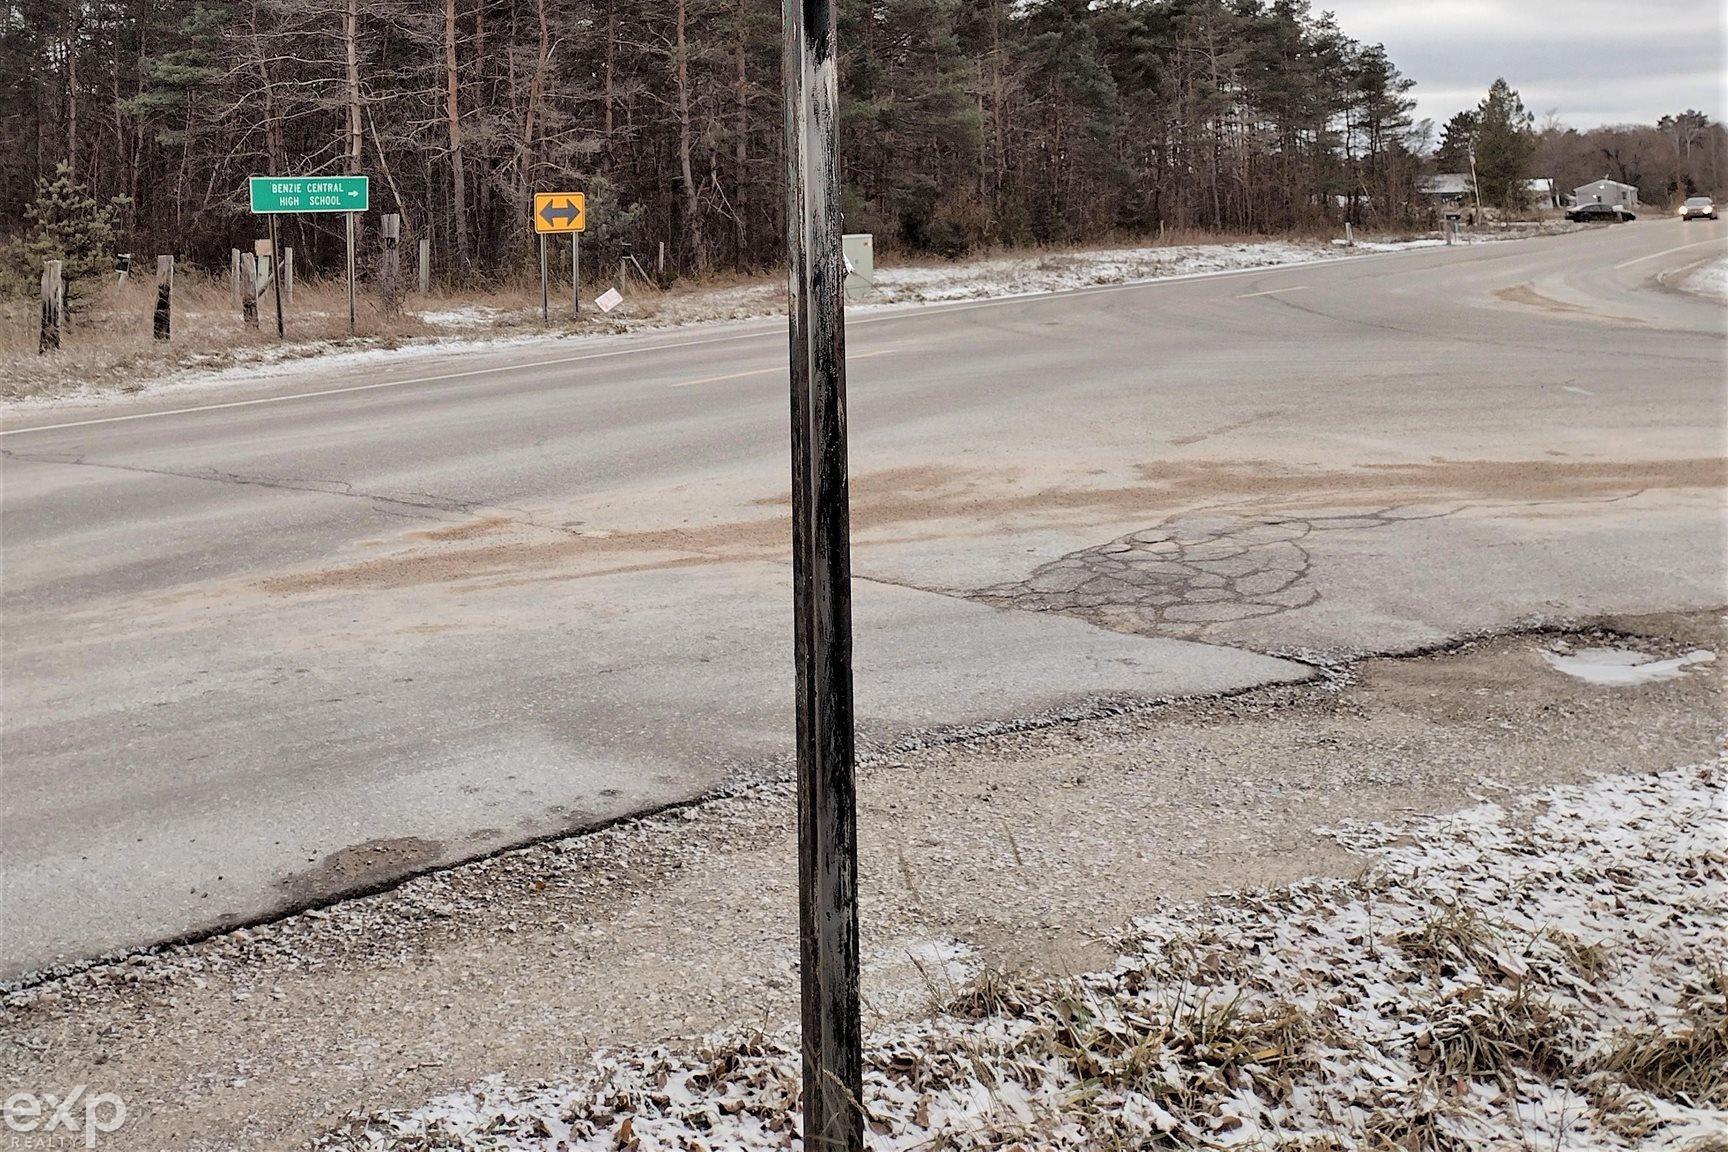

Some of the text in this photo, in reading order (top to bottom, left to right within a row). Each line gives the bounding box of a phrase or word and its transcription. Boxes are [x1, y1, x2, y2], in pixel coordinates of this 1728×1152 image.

[272, 183, 344, 193] BENZIE CENTRAL
[279, 196, 341, 207] HIGH SCHOOL
